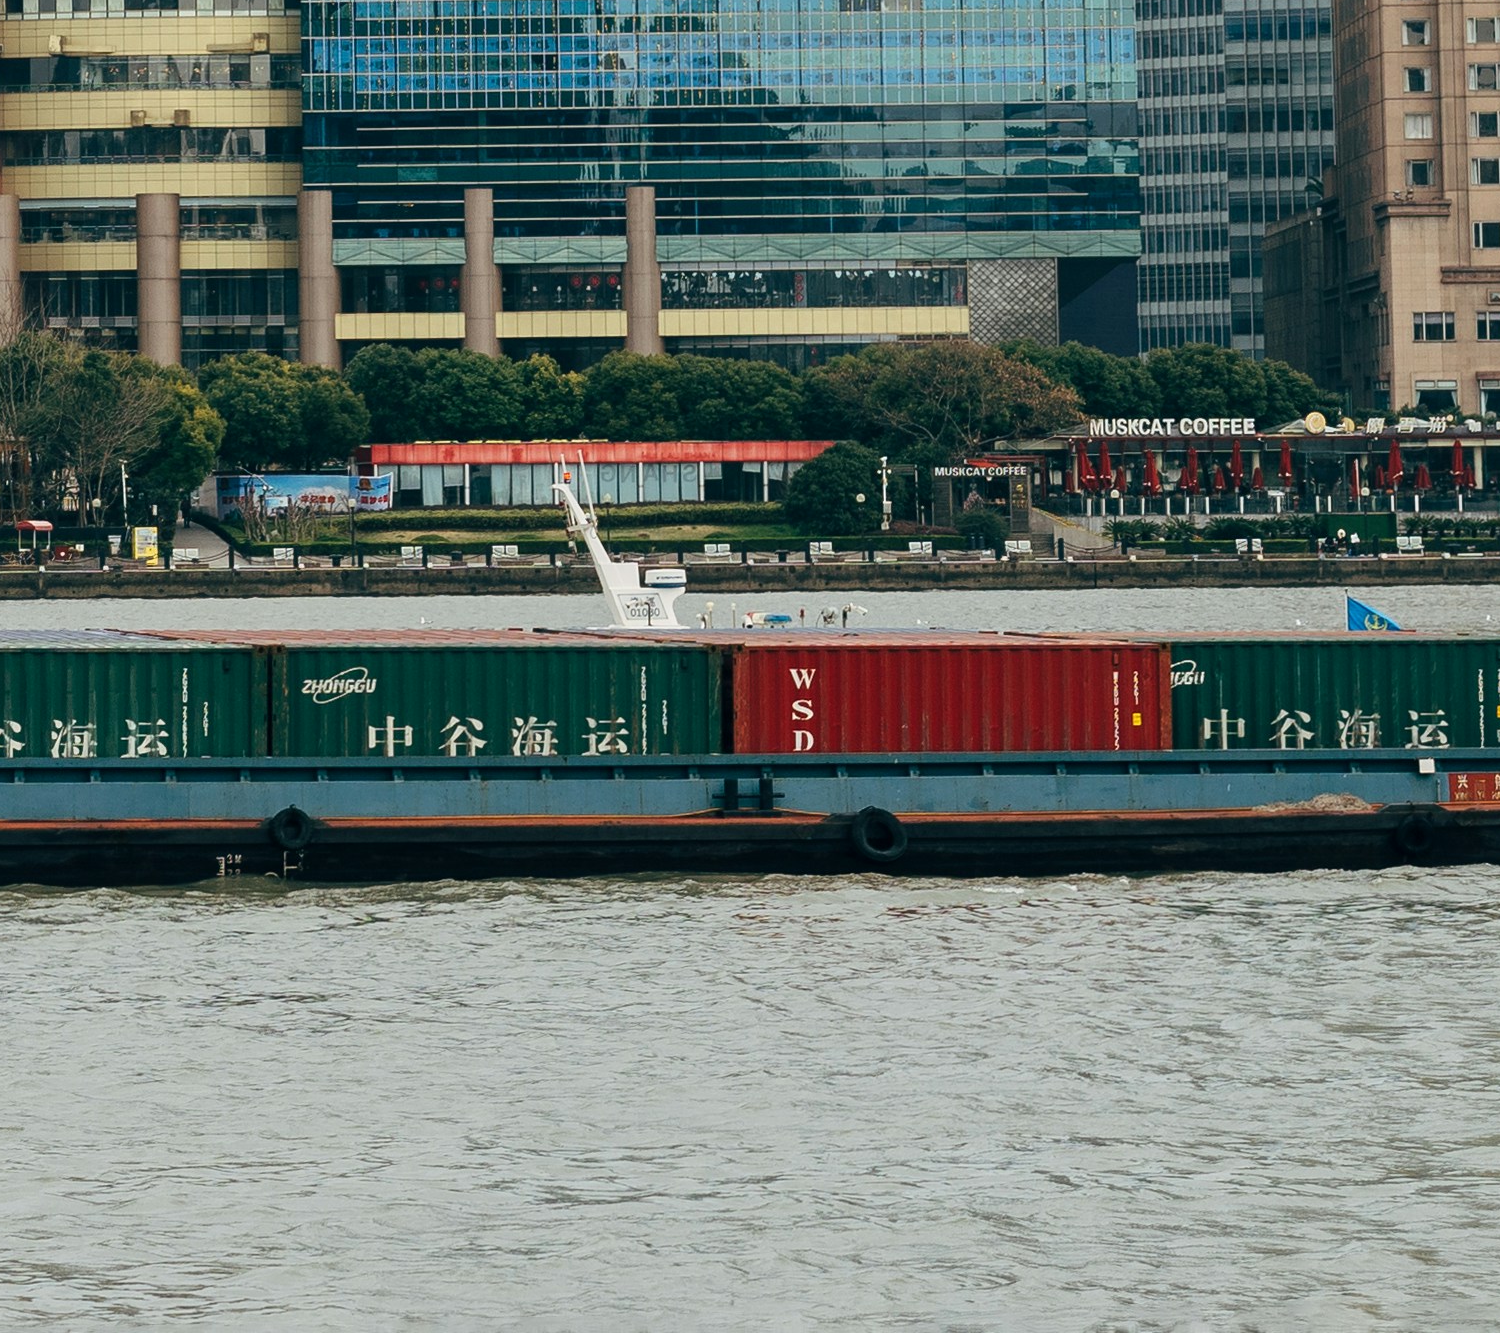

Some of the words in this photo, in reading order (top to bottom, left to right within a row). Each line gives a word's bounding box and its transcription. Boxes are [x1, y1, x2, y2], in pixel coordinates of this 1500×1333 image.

[1089, 417, 1175, 437] MUSKCAT
[1179, 417, 1256, 436] COFFEE
[934, 466, 987, 477] MUSKCAT
[987, 466, 1027, 477] COFFEE
[301, 678, 377, 694] ZHONGGU
[368, 715, 630, 757] 中谷海运
[1203, 708, 1450, 749] 中谷海运
